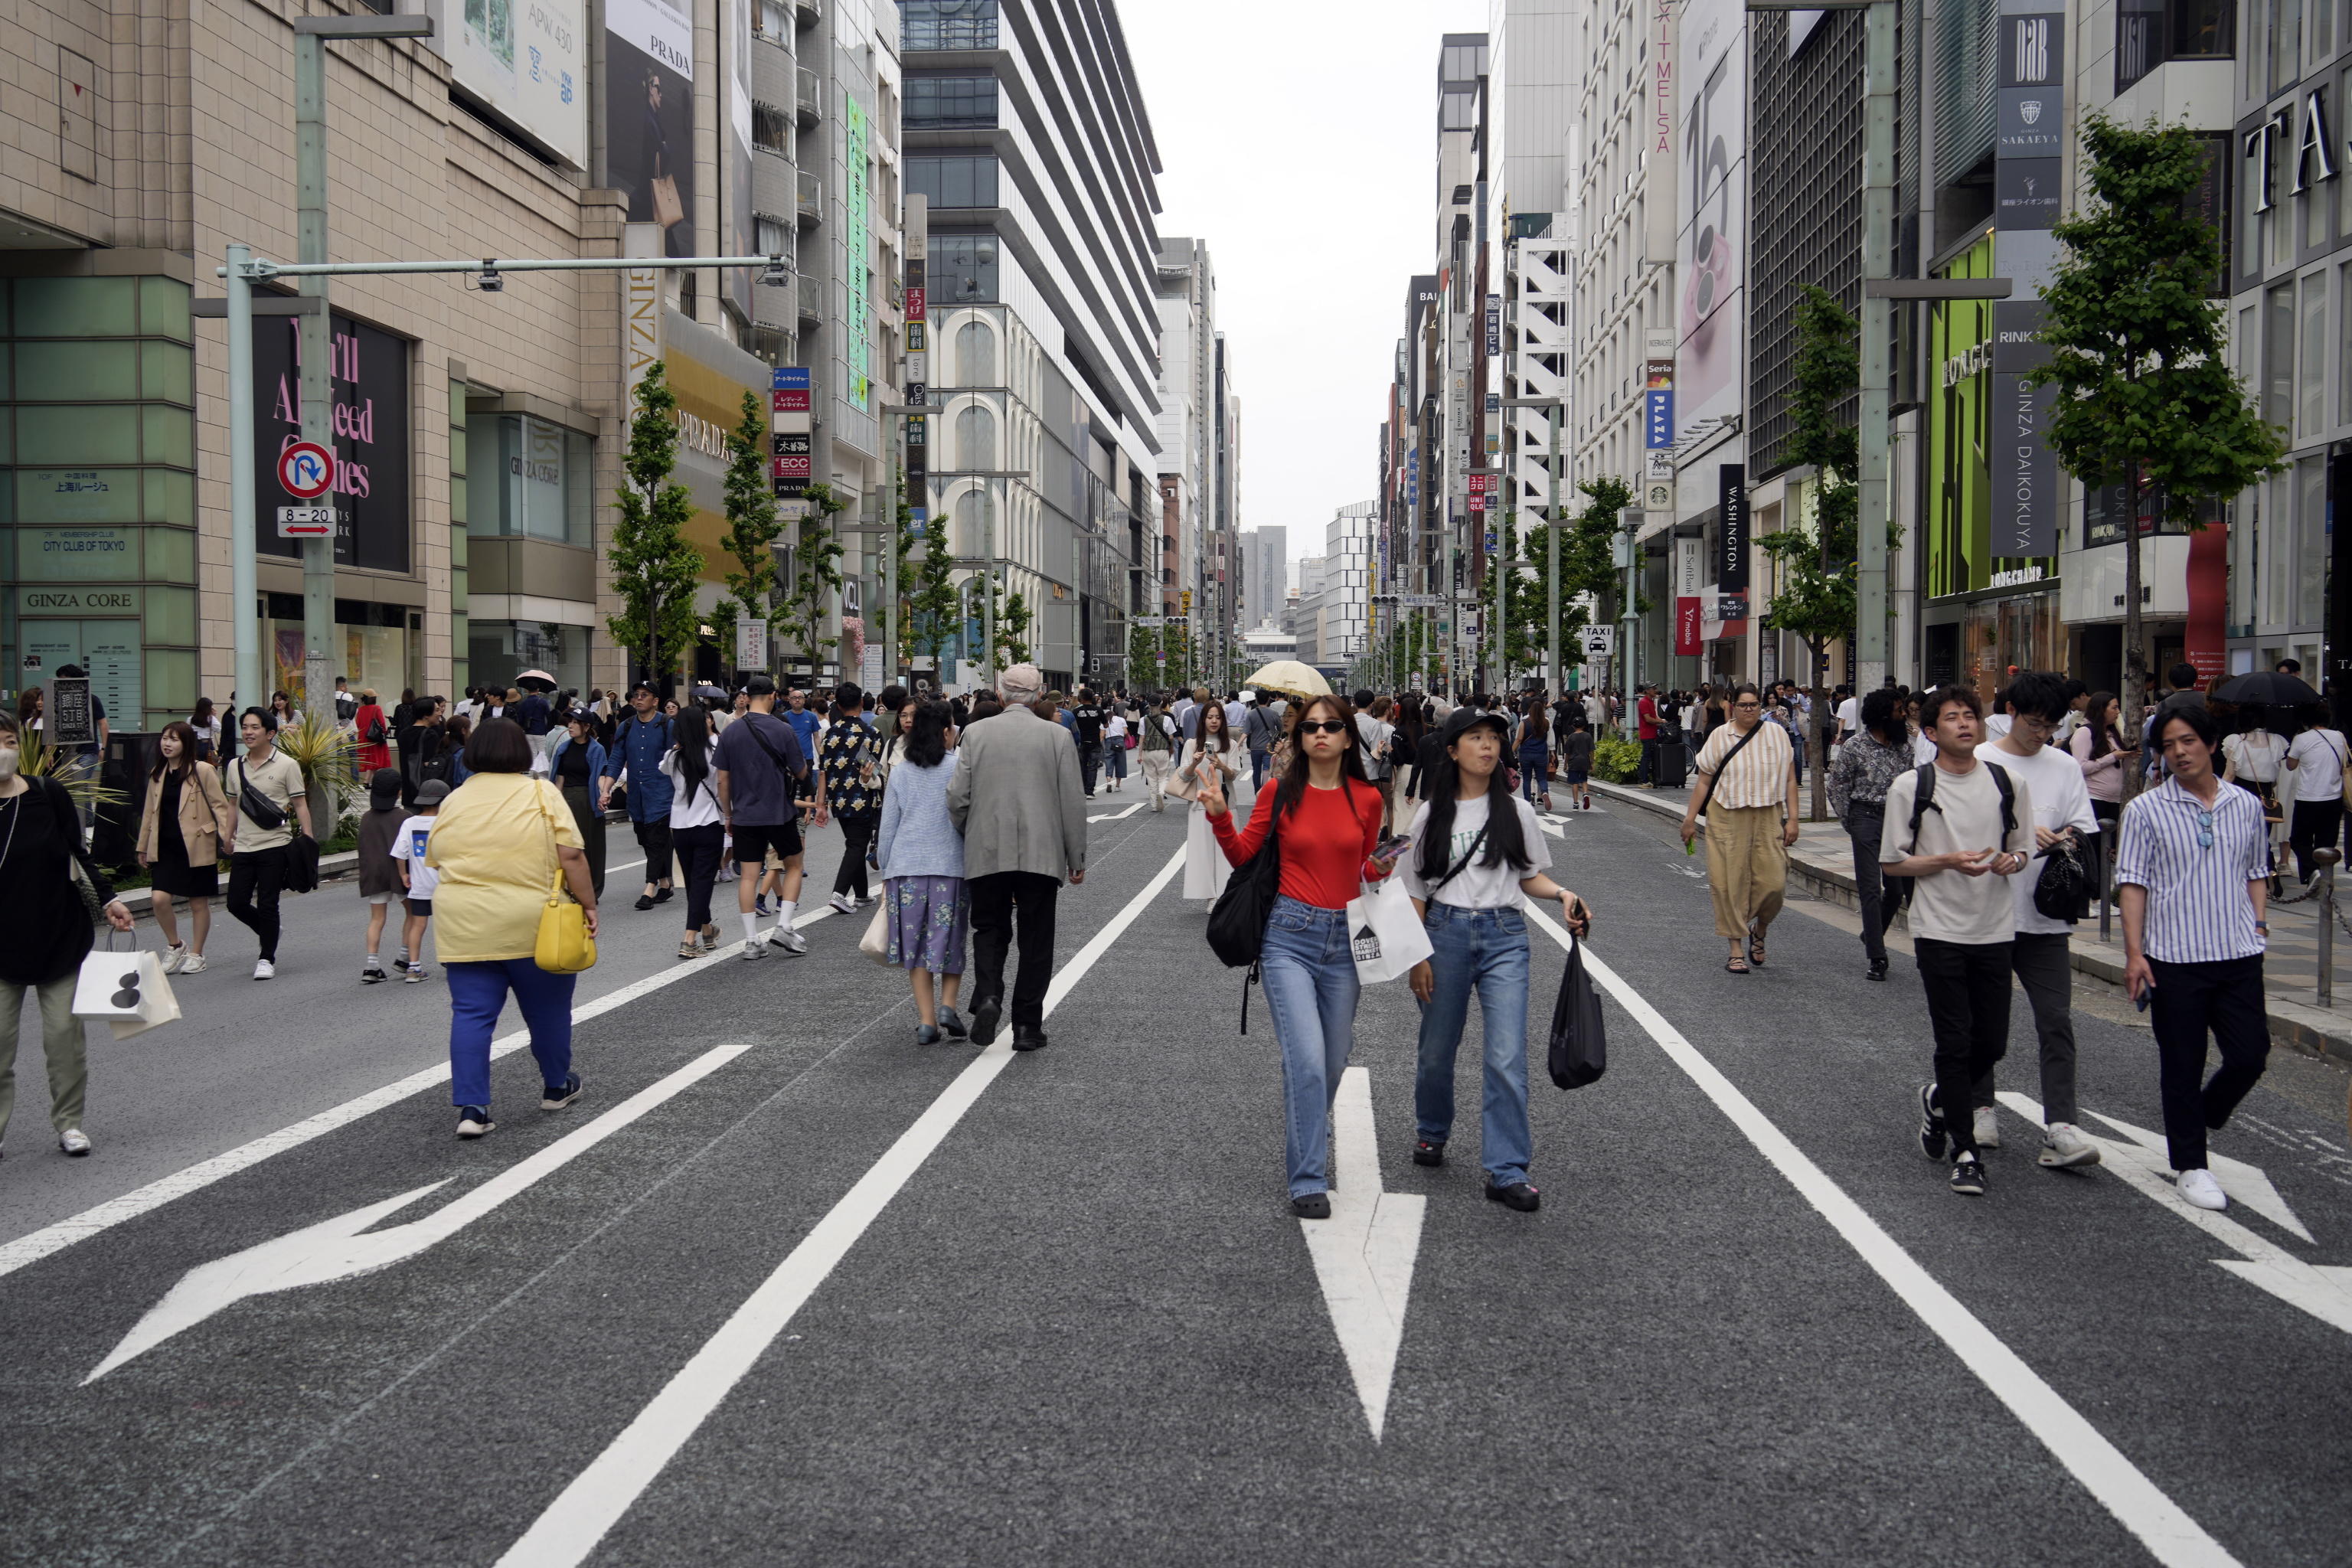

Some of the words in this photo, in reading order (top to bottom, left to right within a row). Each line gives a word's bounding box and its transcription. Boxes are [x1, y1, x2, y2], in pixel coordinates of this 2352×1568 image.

[528, 3, 553, 38] APW
[555, 25, 572, 54] 430
[650, 34, 691, 74] PRADA
[1656, 0, 1671, 153] XITMELSA
[2002, 135, 2058, 145] SAKAEYA
[2244, 89, 2352, 215] TA
[1999, 331, 2042, 343] RINK
[1648, 364, 1672, 373] Seria
[2018, 380, 2033, 438] GINZA
[1655, 396, 1665, 444] PLAZA
[677, 409, 733, 462] PRADA
[781, 458, 808, 469] ECC
[55, 481, 109, 492] 上海ルージュ
[2016, 446, 2033, 550] DAIKOKUYA
[286, 509, 294, 521] 8
[311, 509, 328, 521] 20
[1727, 486, 1738, 571] WASHINGTON
[2092, 524, 2115, 539] RINKAN
[44, 541, 61, 551] CITY
[63, 541, 83, 551] CLUB
[86, 541, 96, 551] OF
[98, 541, 125, 551] TOKYO
[1685, 557, 1694, 595] SoftBank
[1991, 565, 2043, 588] LONGCHAMP
[28, 594, 80, 607] GINZA
[86, 594, 132, 607] CORE
[1847, 663, 1854, 672] UP
[1354, 936, 1379, 945] DOVER
[1354, 942, 1379, 950] STREET
